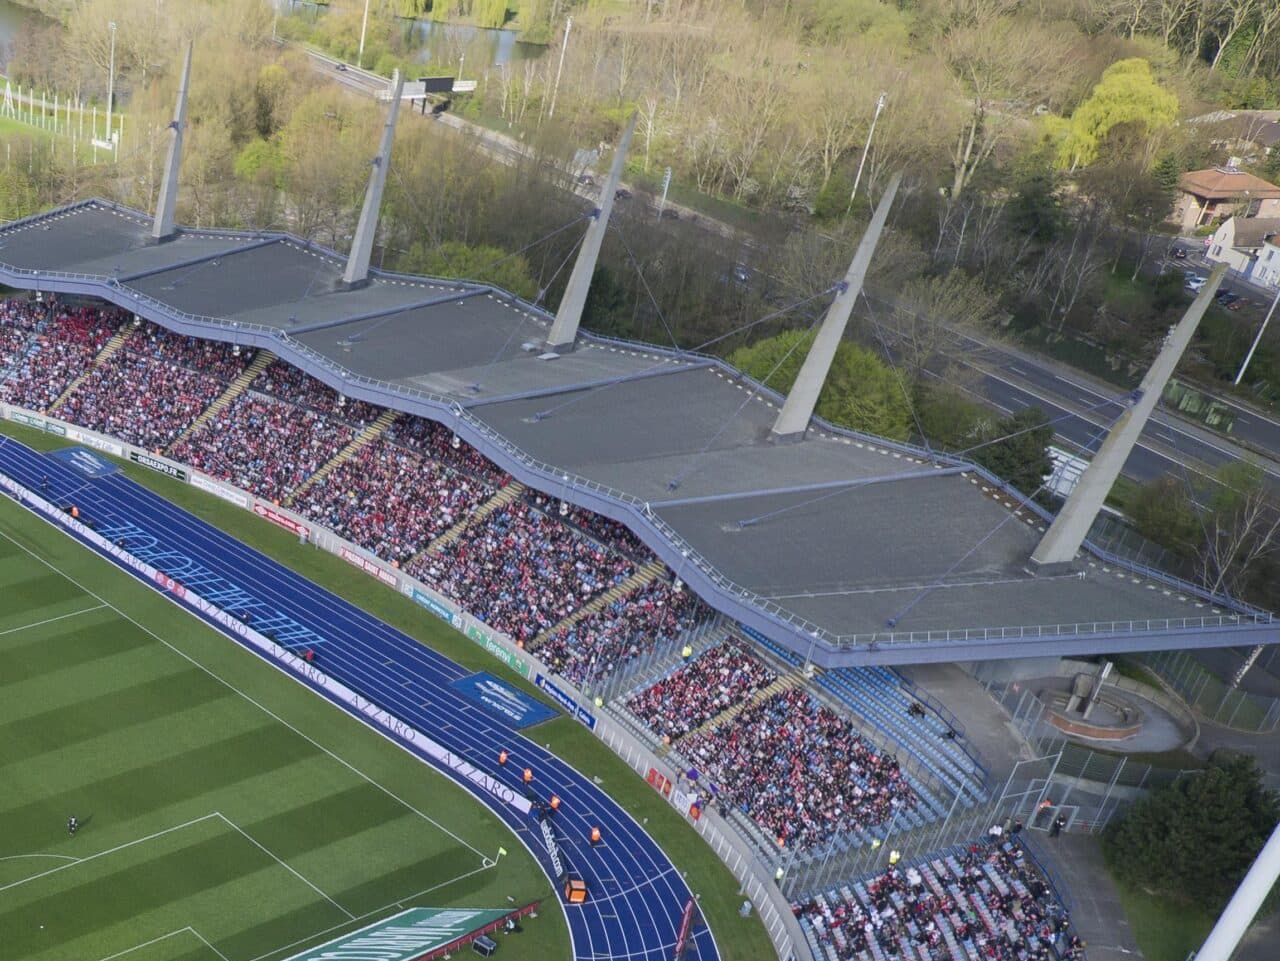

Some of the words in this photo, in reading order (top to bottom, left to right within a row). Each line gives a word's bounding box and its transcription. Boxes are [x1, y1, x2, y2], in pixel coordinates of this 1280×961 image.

[101, 538, 149, 574] AZZARO
[195, 598, 248, 636] AZZARO
[272, 643, 328, 686] AZZARO
[351, 695, 417, 742] AZZARO
[440, 752, 516, 804] AZZARO
